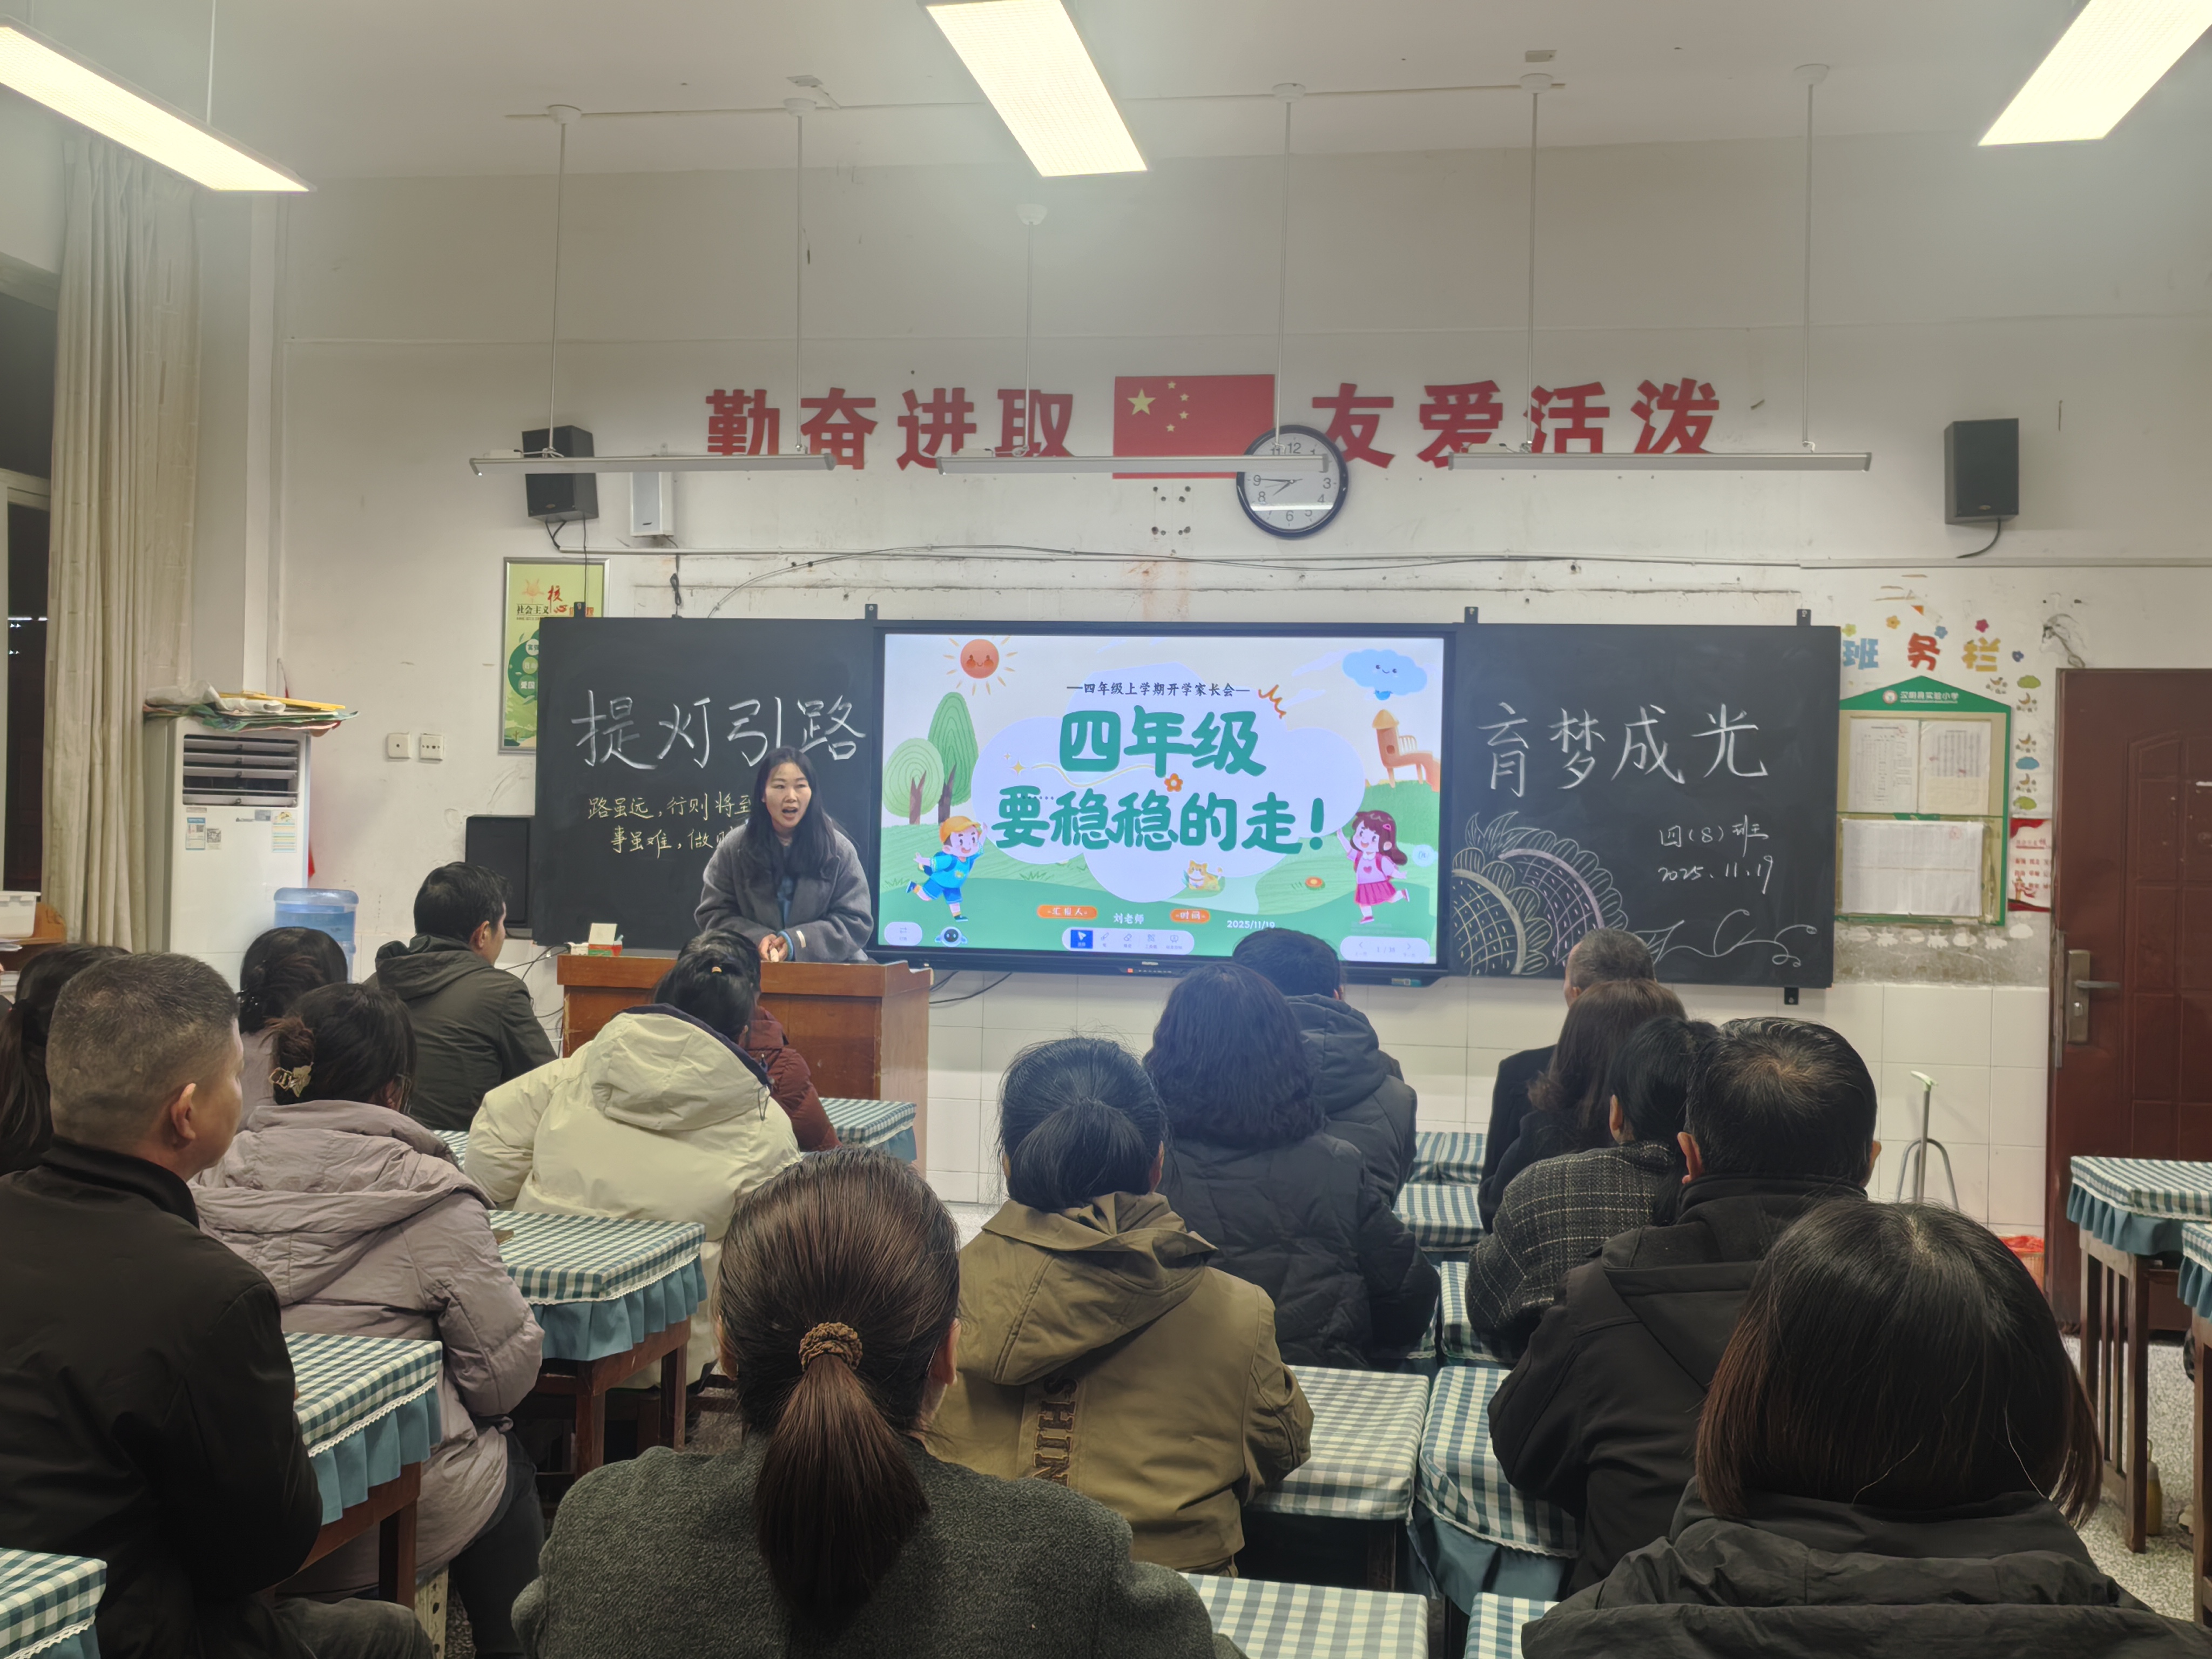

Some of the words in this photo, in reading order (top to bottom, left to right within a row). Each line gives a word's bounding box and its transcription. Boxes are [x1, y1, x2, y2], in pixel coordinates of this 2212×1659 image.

[705, 387, 1075, 471] 勤奋进取
[1312, 377, 1720, 469] 友爱活泼
[1287, 442, 1301, 454] 12
[1323, 477, 1332, 489] 3
[1258, 491, 1266, 502] 8
[516, 604, 549, 615] 社会主义
[571, 689, 866, 770] 提灯引路
[1059, 705, 1267, 778] 四年级
[1478, 702, 1769, 798] 育梦成光
[1113, 912, 1145, 925] 刘老师
